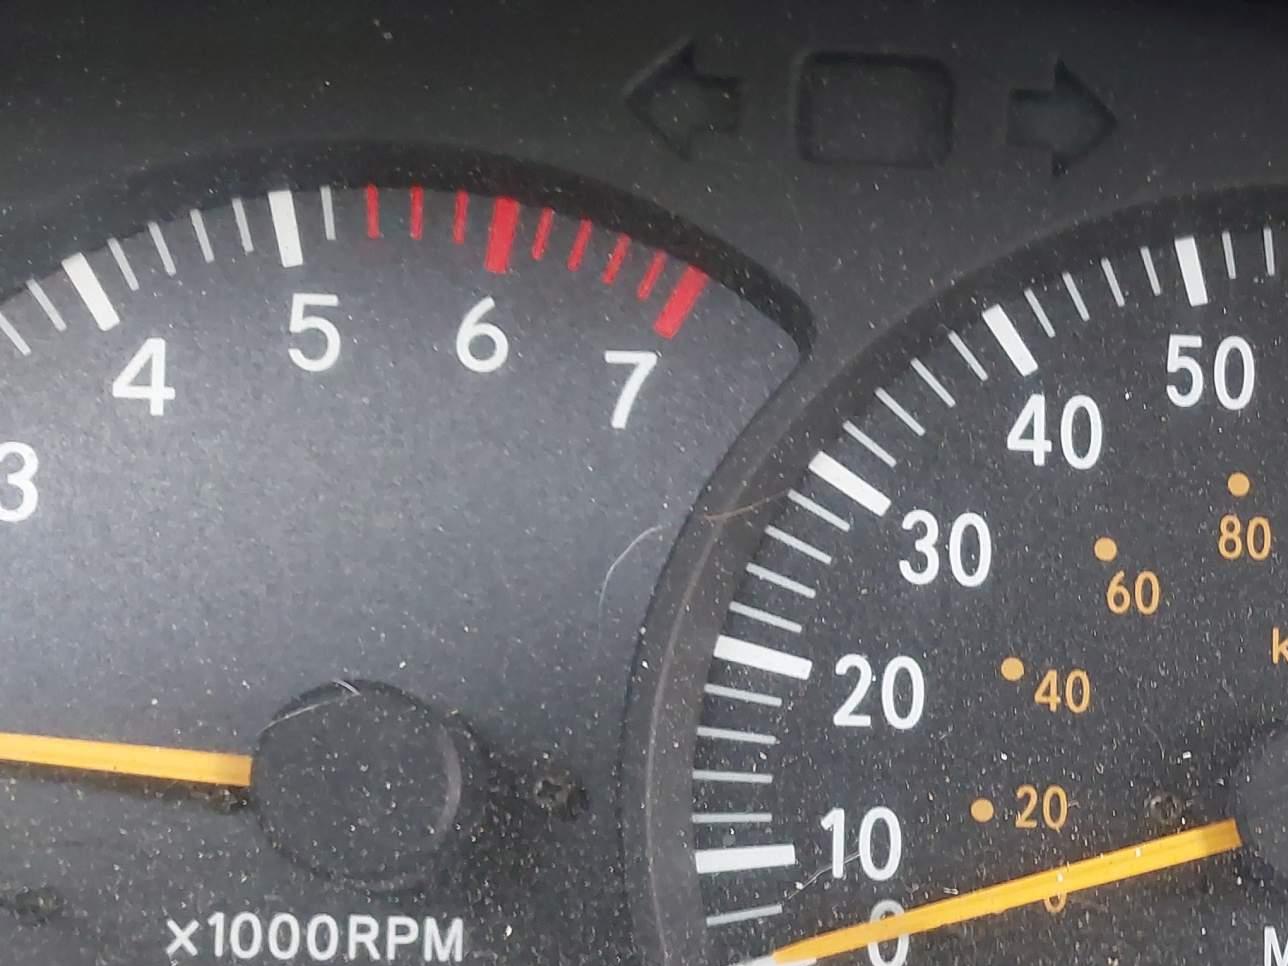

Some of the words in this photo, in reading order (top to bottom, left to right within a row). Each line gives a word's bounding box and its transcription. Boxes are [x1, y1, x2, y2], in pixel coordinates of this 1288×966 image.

[288, 293, 341, 372] 5
[455, 297, 509, 374] 6
[112, 337, 176, 417] 4
[604, 350, 658, 429] 7
[1166, 334, 1256, 410] 50
[1006, 394, 1103, 470] 40
[898, 509, 992, 589] 30
[1217, 515, 1273, 562] 80
[1106, 570, 1160, 615] 60
[832, 654, 925, 731] 20
[1034, 669, 1090, 714] 40
[820, 806, 902, 882] 10
[1015, 785, 1069, 830] 20
